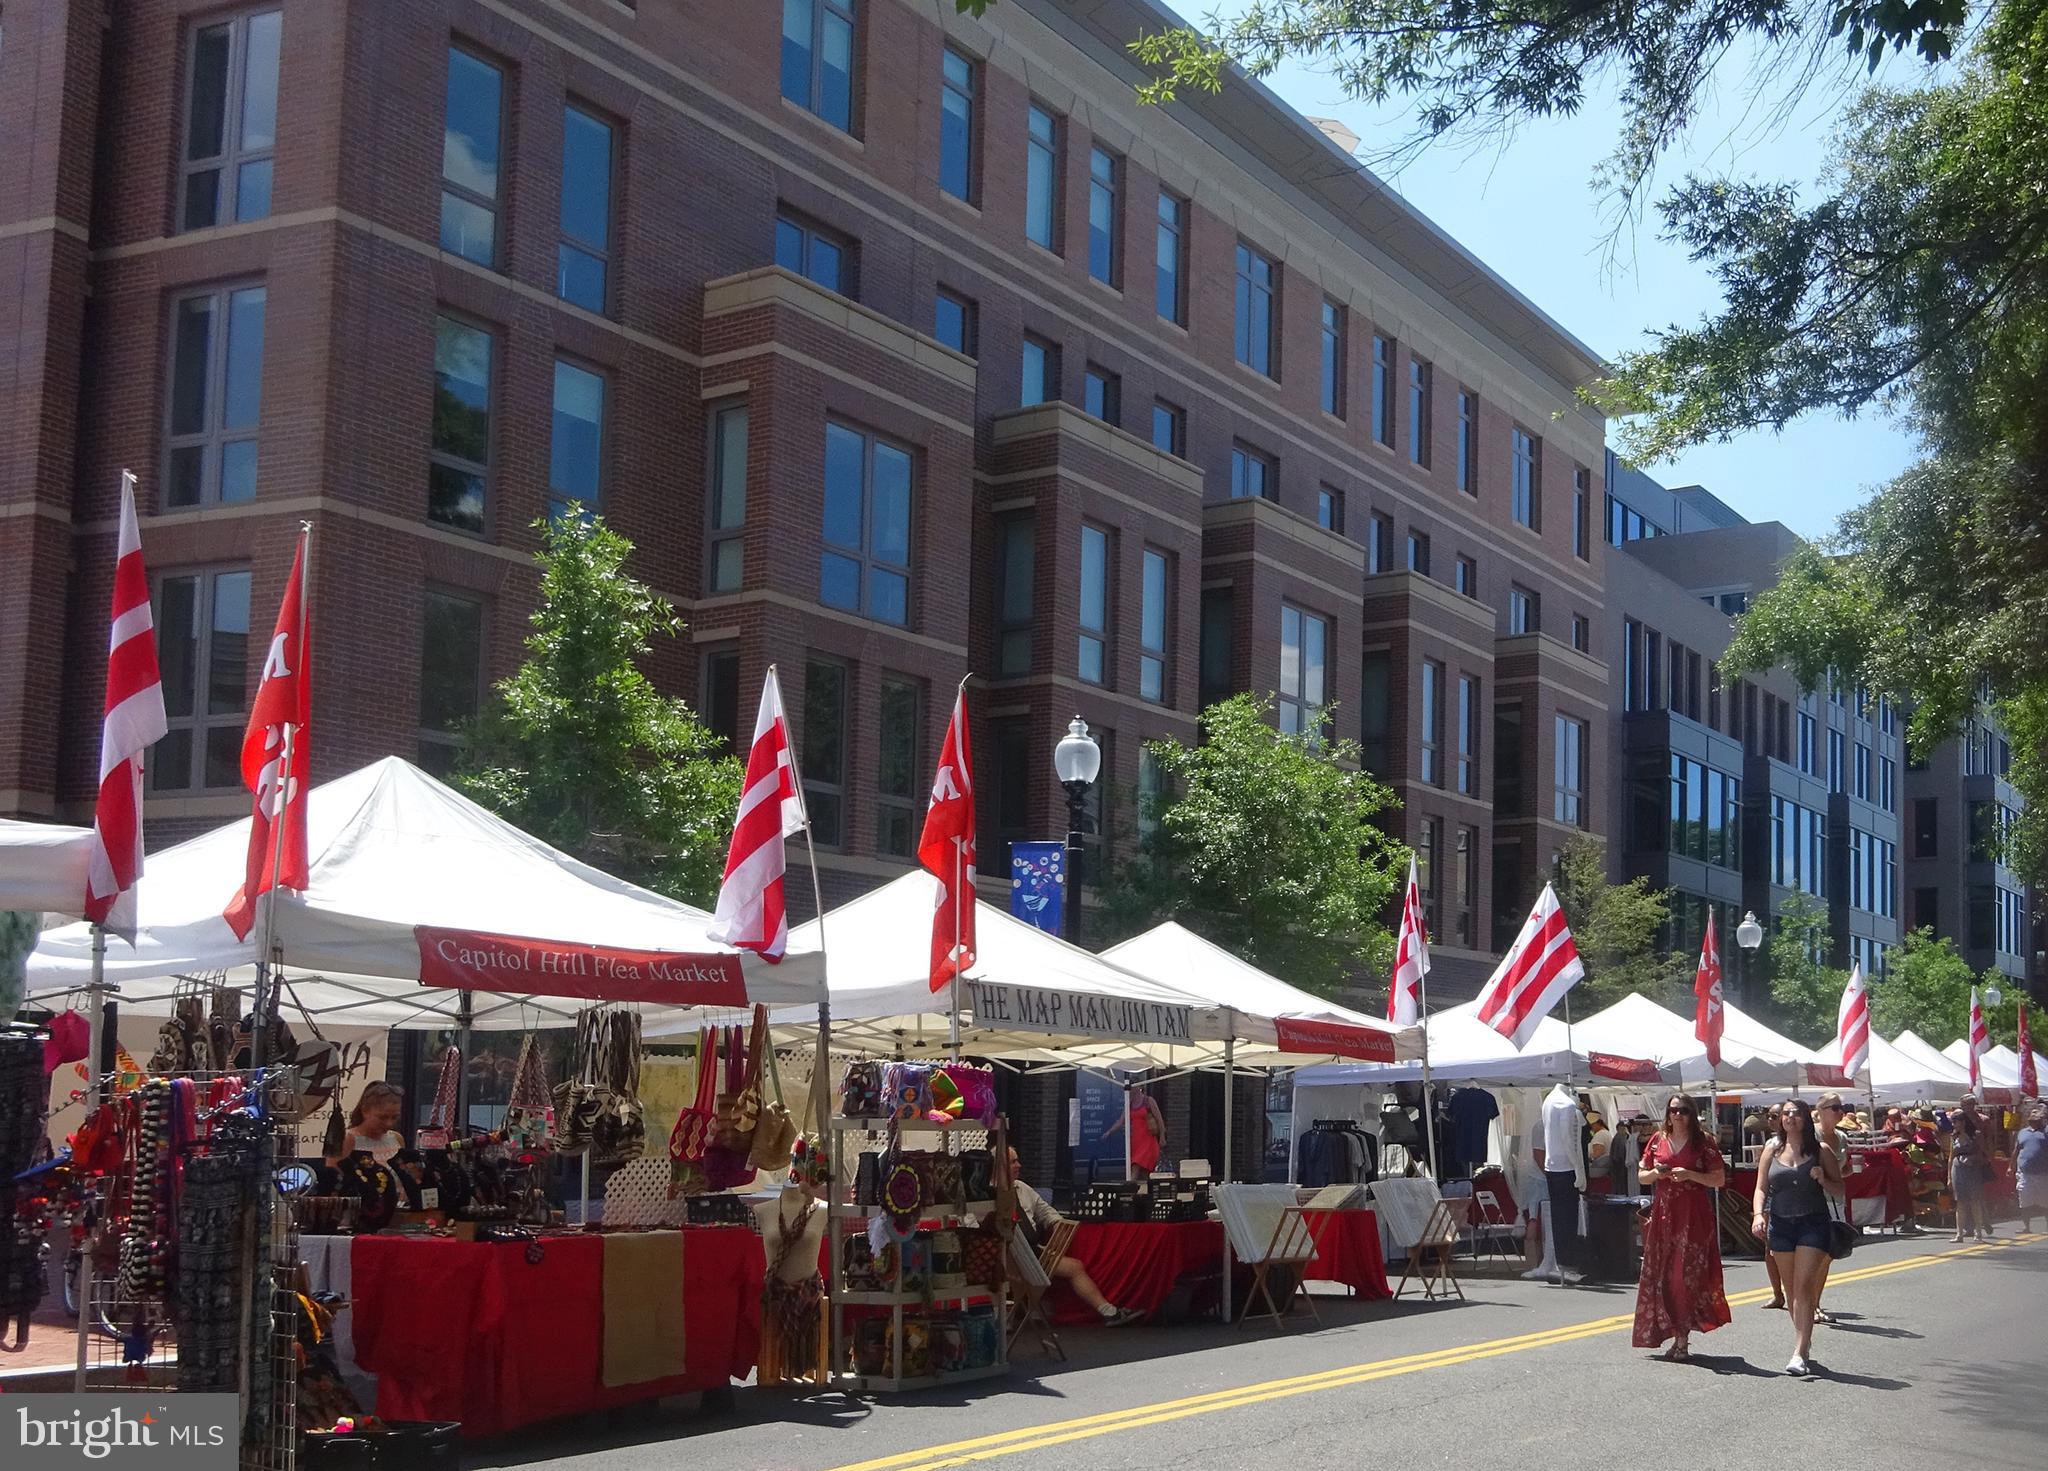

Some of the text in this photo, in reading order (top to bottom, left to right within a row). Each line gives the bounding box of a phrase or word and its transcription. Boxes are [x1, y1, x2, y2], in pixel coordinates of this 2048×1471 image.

[437, 938, 729, 984] Capitol Hill Flea Market
[967, 981, 1011, 1021] THE
[1017, 989, 1062, 1026] MAP
[1069, 994, 1112, 1031] MAN
[1152, 1004, 1190, 1039] TAM
